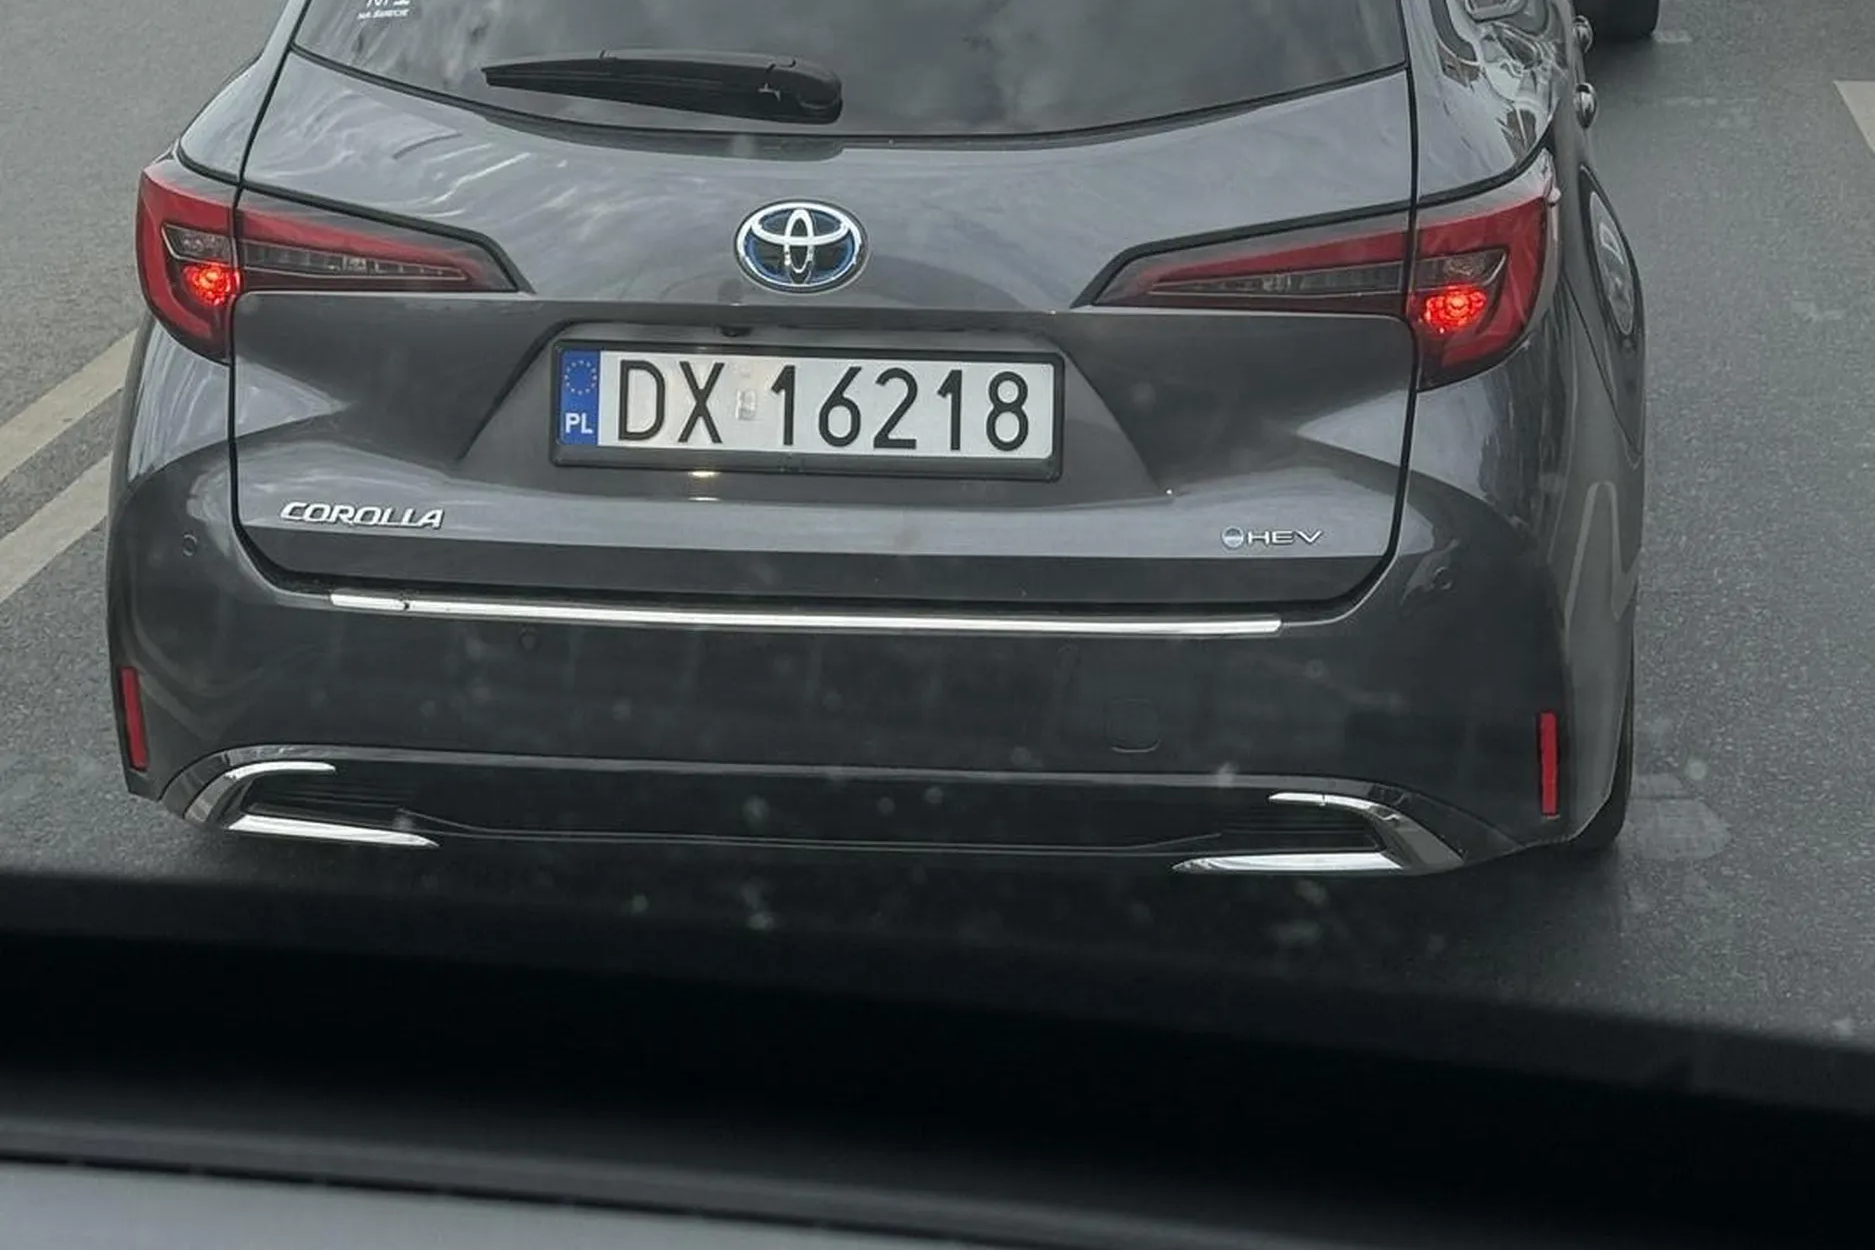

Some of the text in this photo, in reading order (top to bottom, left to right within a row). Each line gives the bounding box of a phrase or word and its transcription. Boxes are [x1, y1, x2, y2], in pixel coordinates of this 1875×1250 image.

[617, 358, 1030, 452] DX 16218
[565, 412, 594, 435] PL
[279, 501, 445, 529] COROLLA
[1247, 529, 1323, 546] HEV
